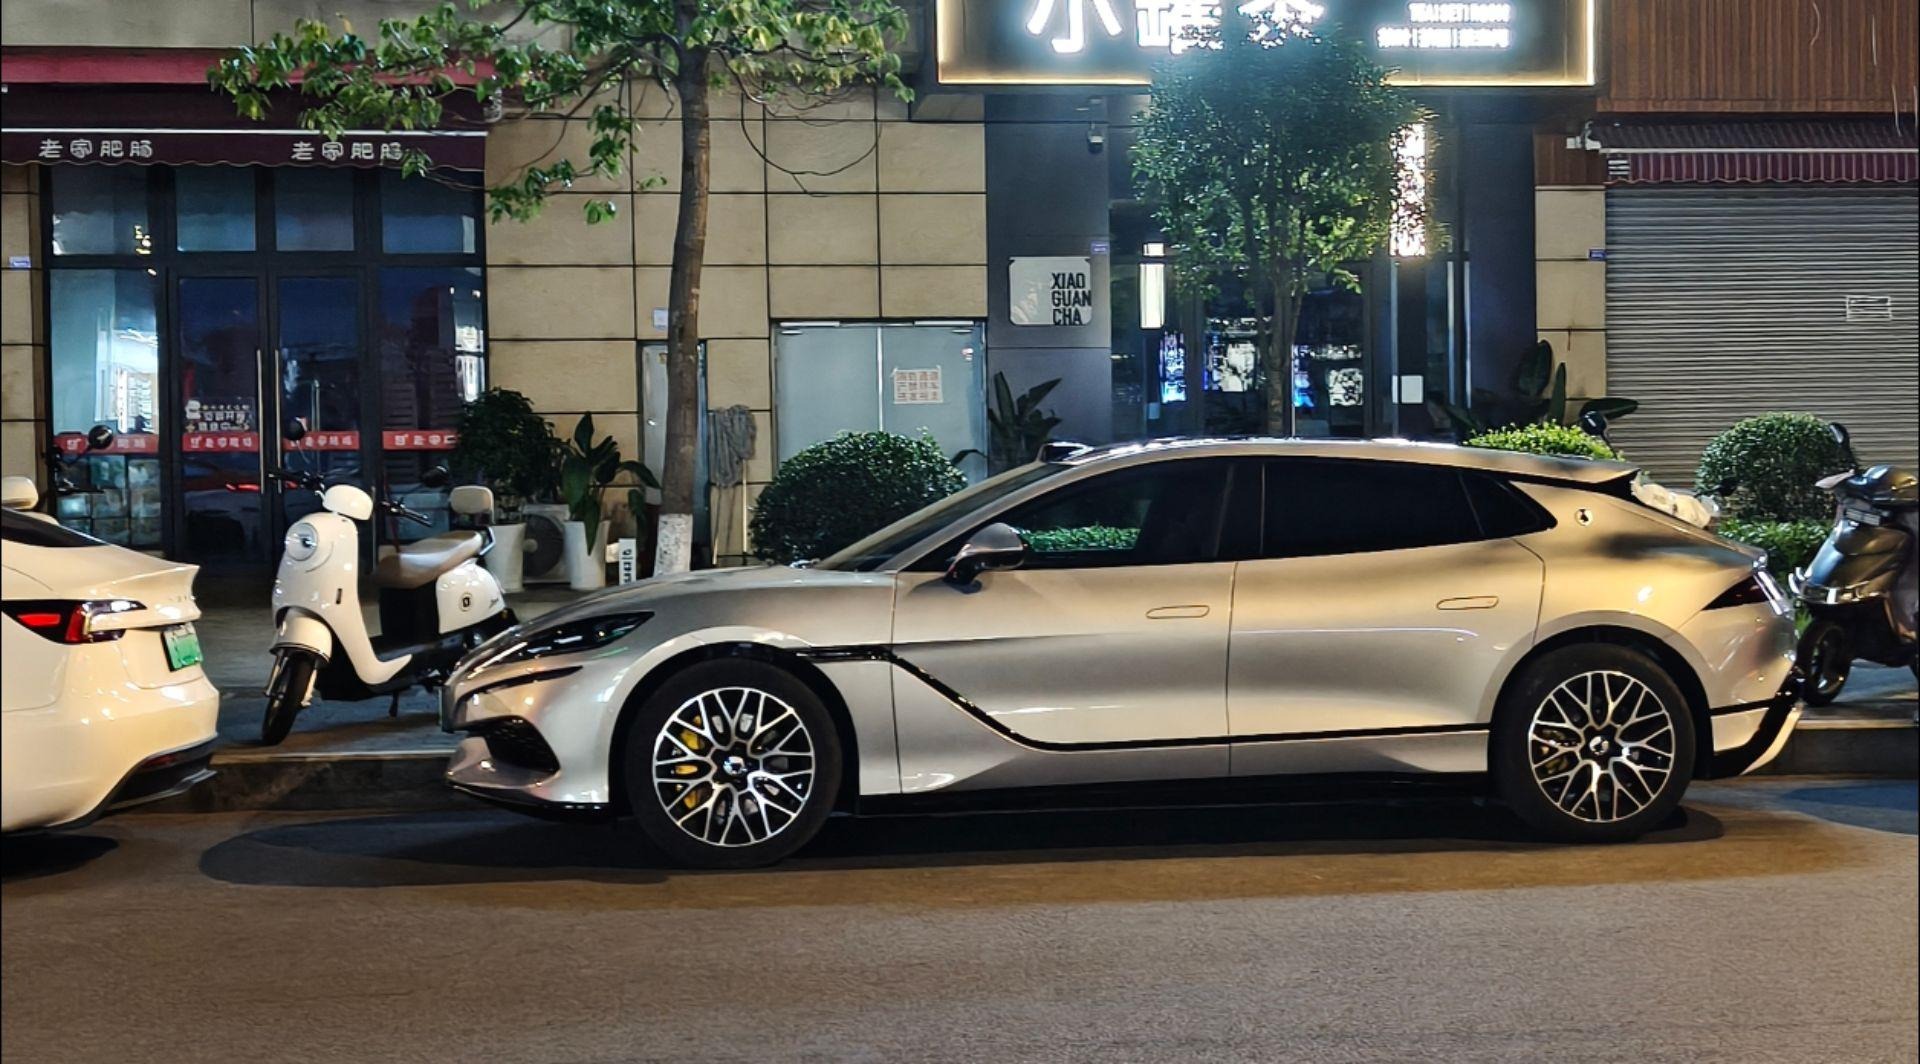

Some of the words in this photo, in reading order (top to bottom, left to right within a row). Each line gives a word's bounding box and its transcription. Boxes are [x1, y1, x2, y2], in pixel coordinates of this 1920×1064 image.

[1051, 272, 1086, 290] XIAO
[1051, 289, 1092, 307] GUAN
[1052, 307, 1083, 326] CHA
